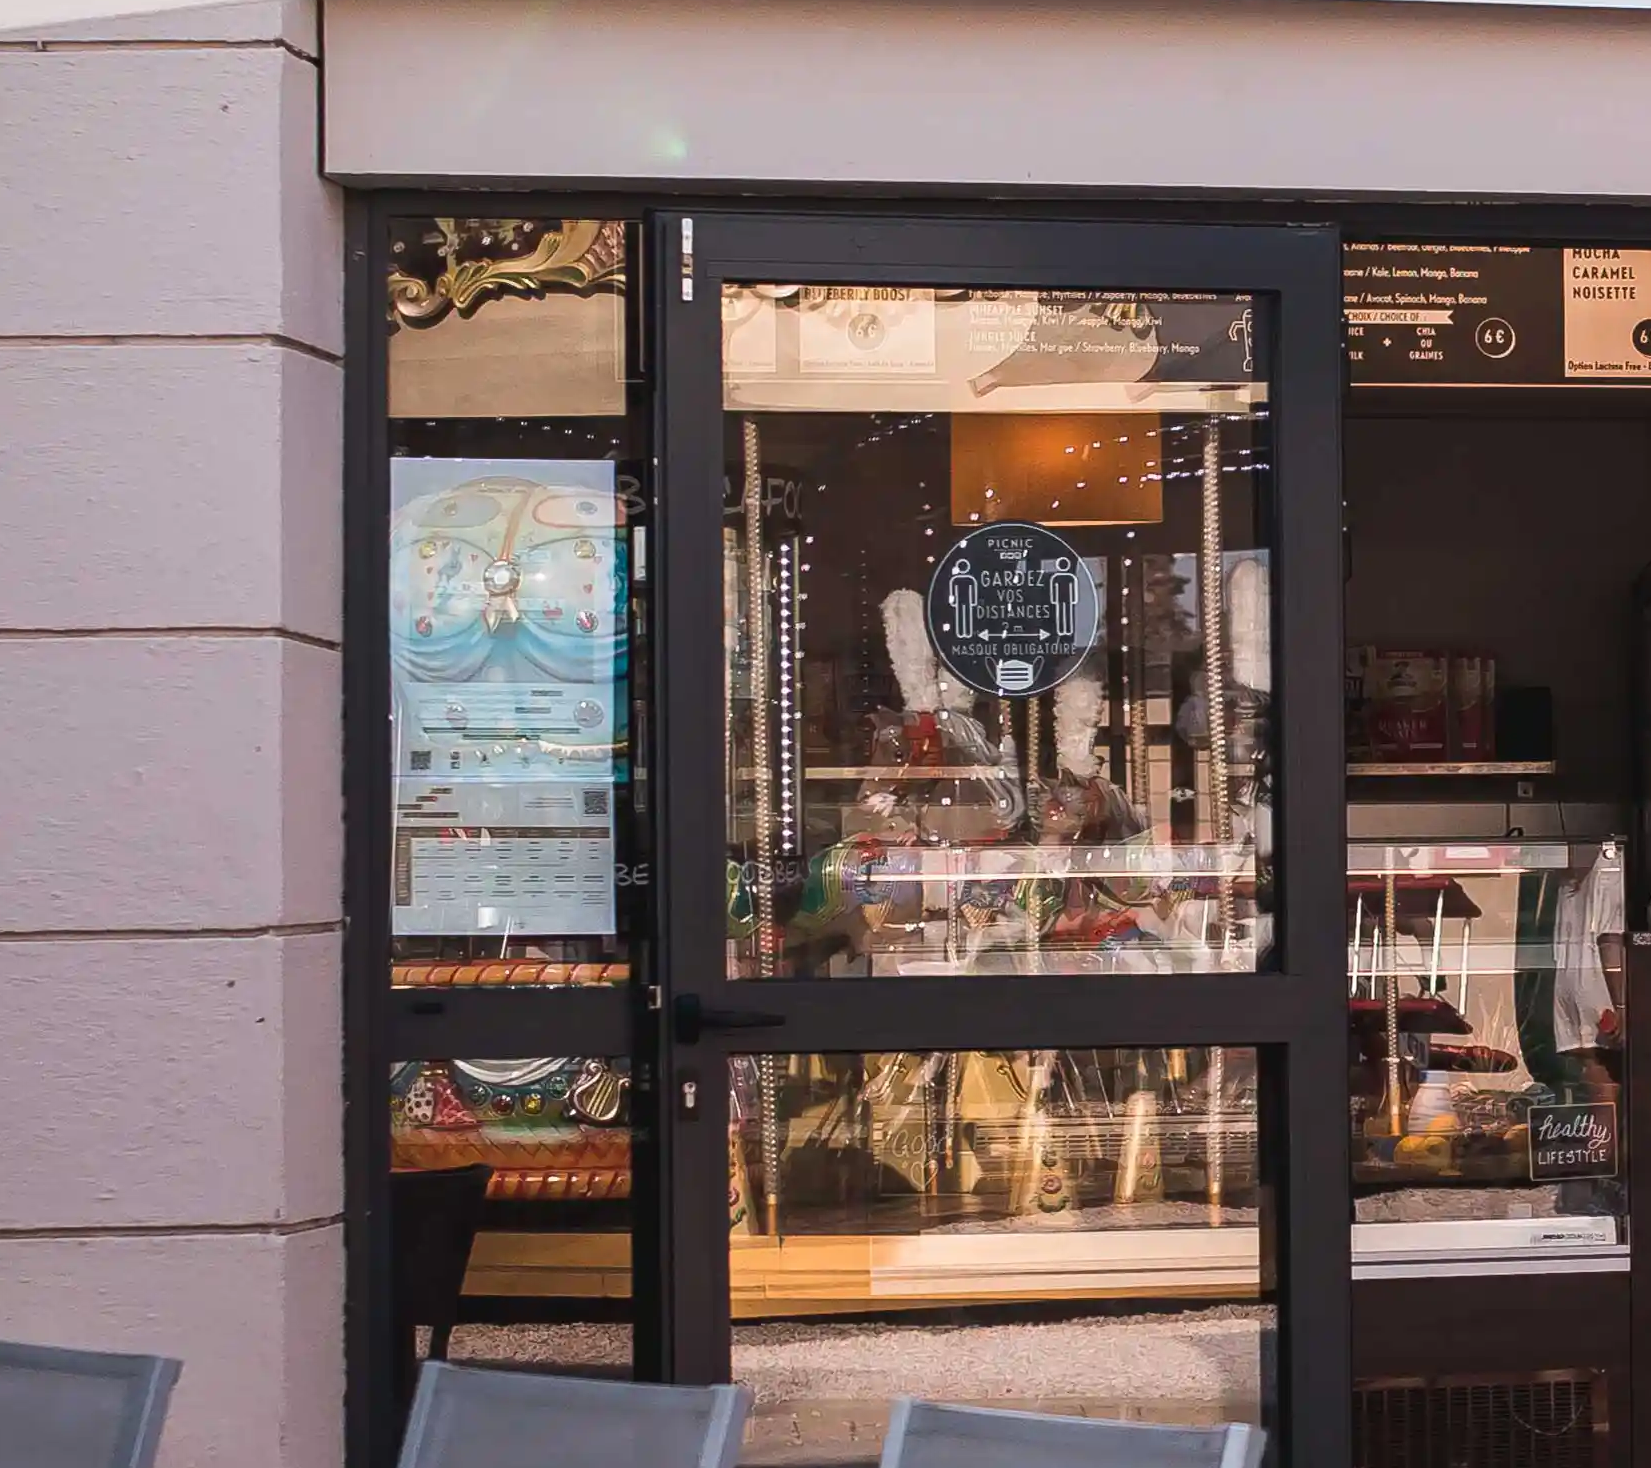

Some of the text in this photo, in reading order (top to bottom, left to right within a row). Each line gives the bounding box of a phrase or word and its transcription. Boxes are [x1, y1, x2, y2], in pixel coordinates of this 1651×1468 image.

[1572, 266, 1636, 280] CARAMEL
[1572, 286, 1636, 300] NOISETTE
[1380, 312, 1408, 322] CHOICE
[1416, 327, 1437, 336] CHIA
[1172, 344, 1200, 355] Mango
[1420, 339, 1432, 348] OU
[1409, 351, 1444, 361] GRAINES
[1568, 361, 1593, 372] Option
[1625, 361, 1642, 371] Free
[987, 538, 1033, 549] PICNIC
[980, 570, 1045, 588] GARDEZ
[996, 590, 1024, 602] VOS
[976, 604, 1050, 619] DISTANCES
[952, 643, 1077, 656] MASQUE OBLIGATOIRE
[1538, 1114, 1611, 1149] healthy
[1538, 1149, 1606, 1165] LIFESTYLE
